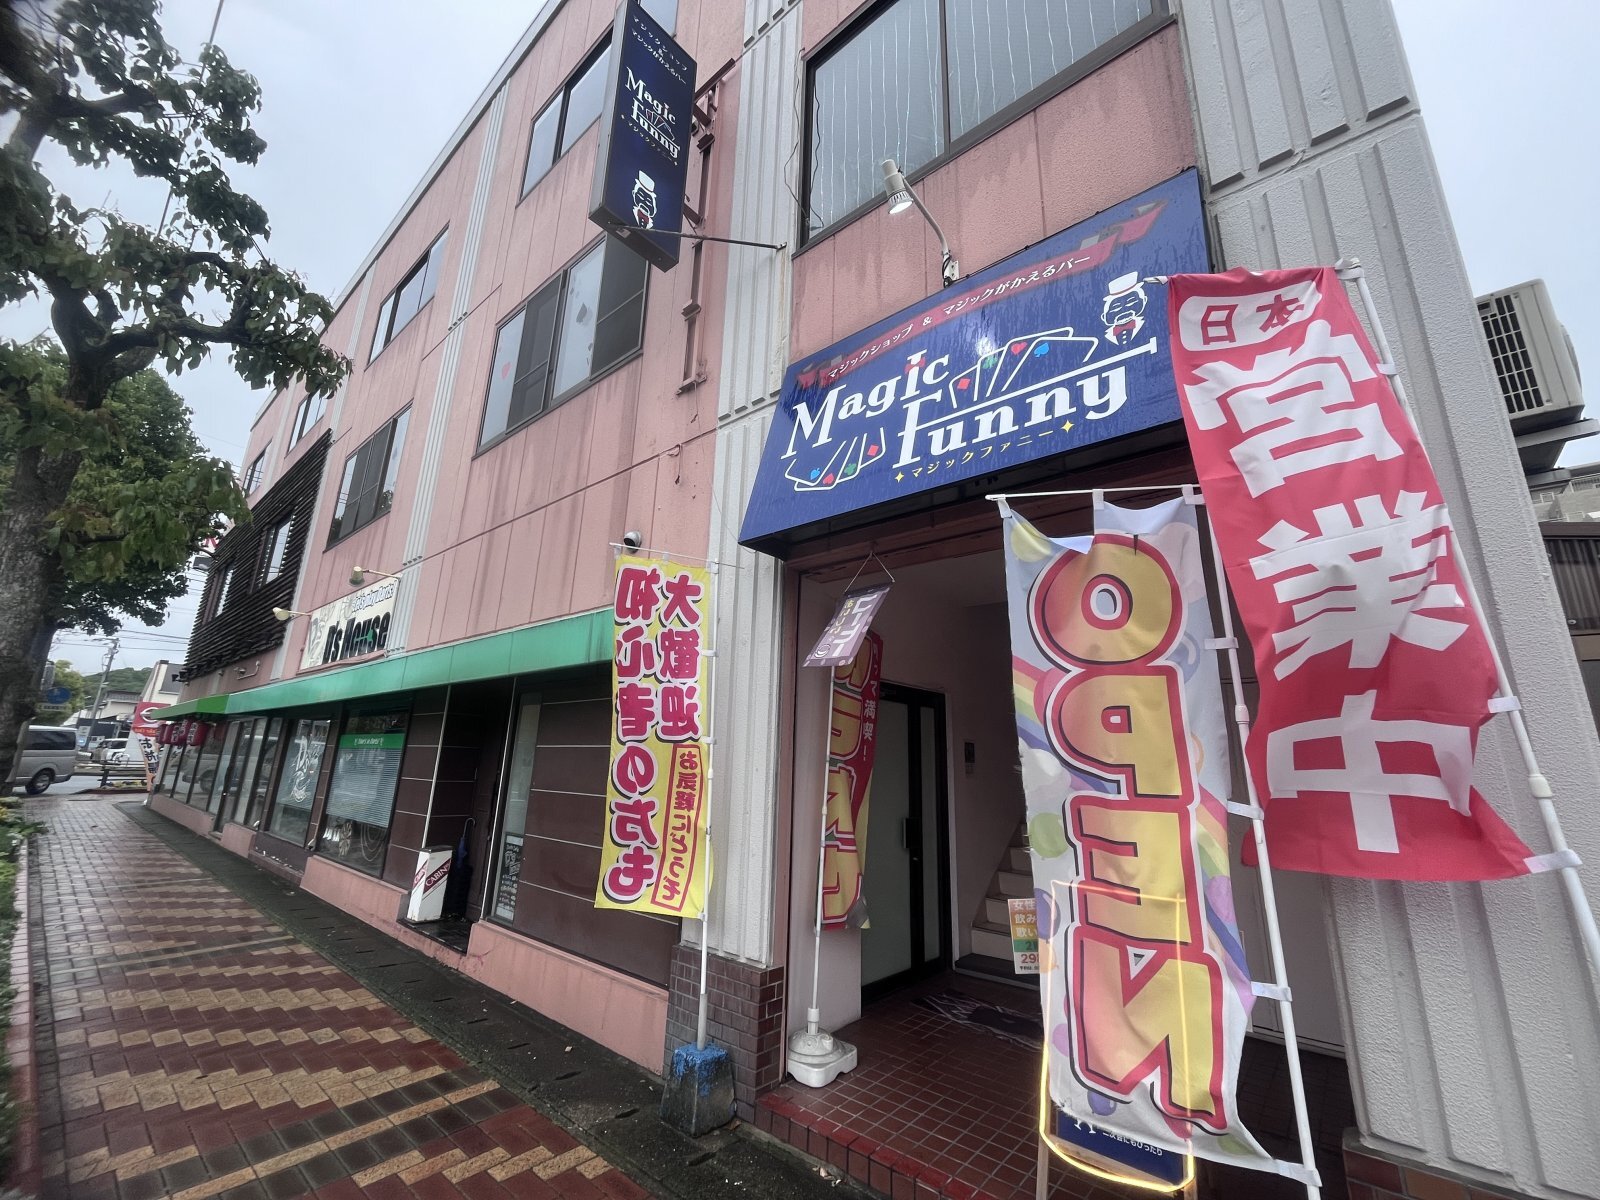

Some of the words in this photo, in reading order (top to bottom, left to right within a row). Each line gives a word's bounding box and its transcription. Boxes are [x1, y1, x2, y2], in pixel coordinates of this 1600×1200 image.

[625, 66, 676, 125] Magic
[631, 97, 681, 159] Funny
[828, 324, 914, 378] マジックショップ
[922, 316, 933, 327] &
[943, 256, 1091, 316] マジックがかえるバー
[781, 349, 951, 461] Magic
[892, 363, 1132, 470] Funny
[911, 429, 1055, 478] マジックファニー
